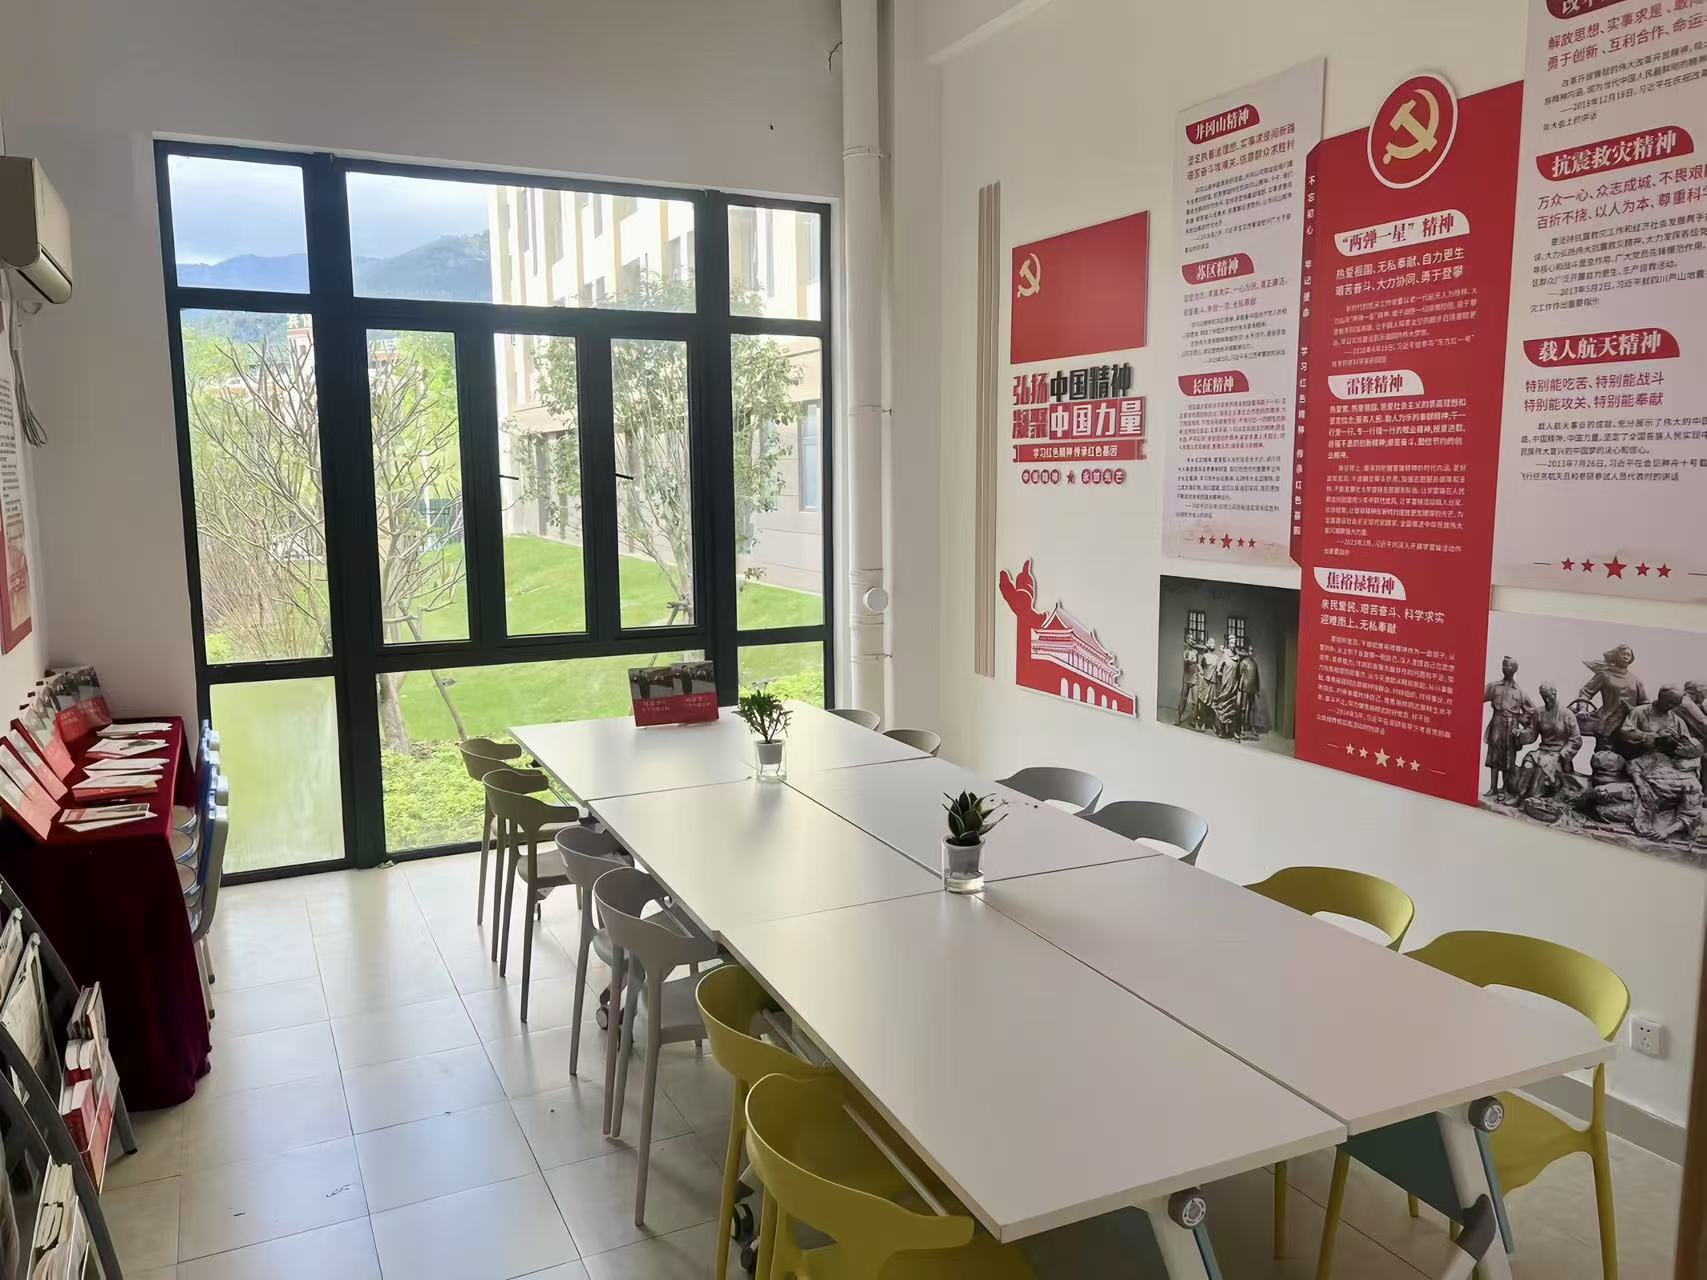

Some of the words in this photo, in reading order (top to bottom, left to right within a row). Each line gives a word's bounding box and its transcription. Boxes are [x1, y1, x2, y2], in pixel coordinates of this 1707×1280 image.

[1547, 13, 1707, 72] 勇于创新、互利合作、命运
[1196, 108, 1249, 140] 井冈山精神
[1552, 130, 1676, 177] 抗震救灾精神
[1538, 164, 1707, 210] 万众一心、众志成城、不畏艰
[1196, 257, 1239, 280] 苏区精神
[1538, 331, 1661, 362] 载人航天精神
[1013, 362, 1132, 405] 弘扬中国精神
[1193, 376, 1234, 395] 长征精神
[1347, 374, 1403, 395] 雷锋精神
[1525, 372, 1664, 393] 特别能吃苦、特别能战斗
[1524, 392, 1664, 413] 特别能攻关、特别能奉献
[1012, 400, 1142, 439] 凝聚中国力量
[1327, 572, 1395, 595] 焦裕禄精神
